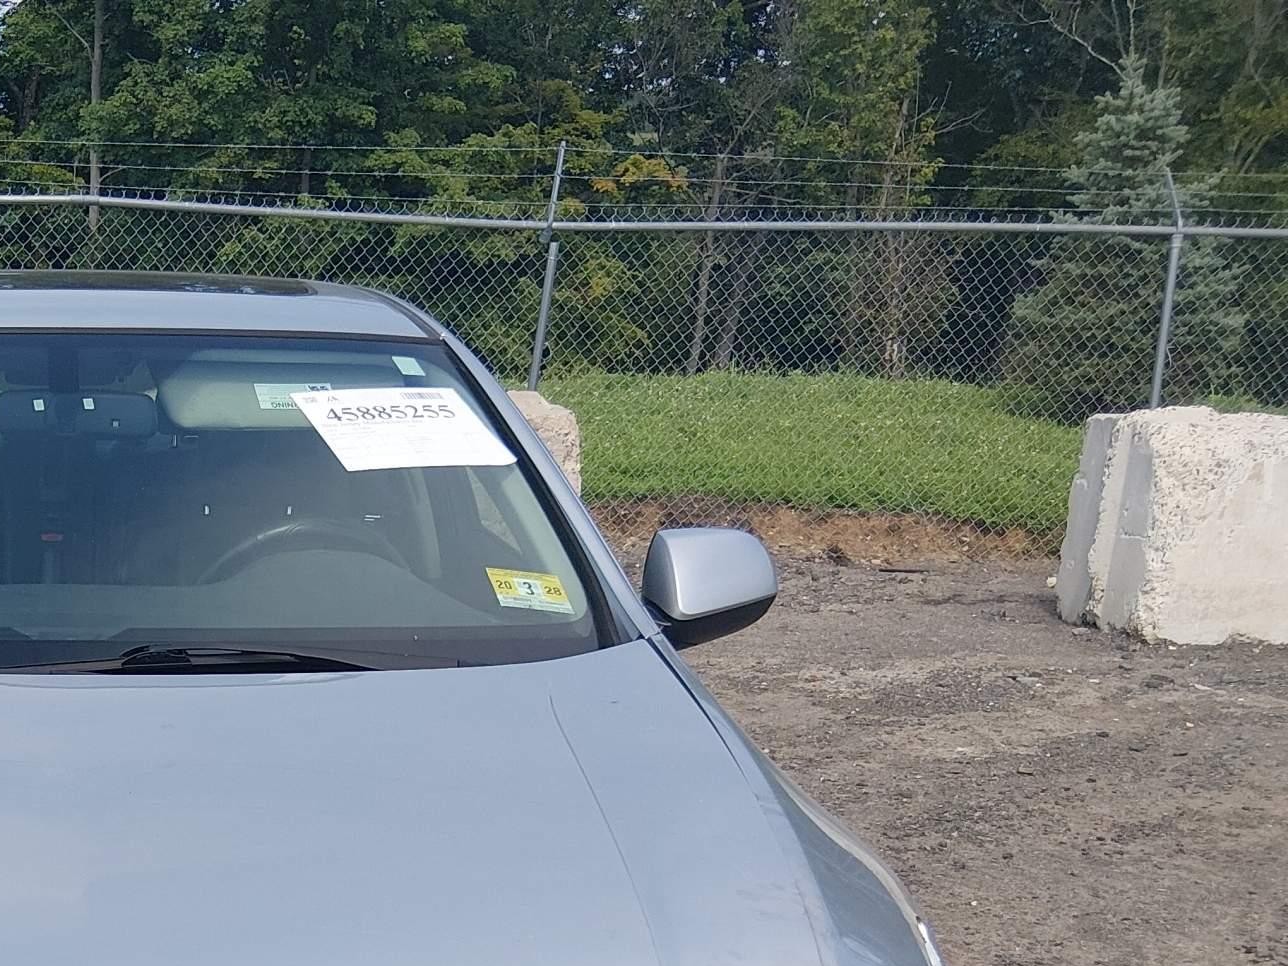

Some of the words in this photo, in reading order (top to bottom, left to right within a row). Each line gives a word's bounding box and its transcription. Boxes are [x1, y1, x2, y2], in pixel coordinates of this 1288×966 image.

[326, 404, 456, 422] 45885255
[496, 579, 513, 590] 20
[522, 581, 535, 595] 3
[544, 585, 562, 596] 28
